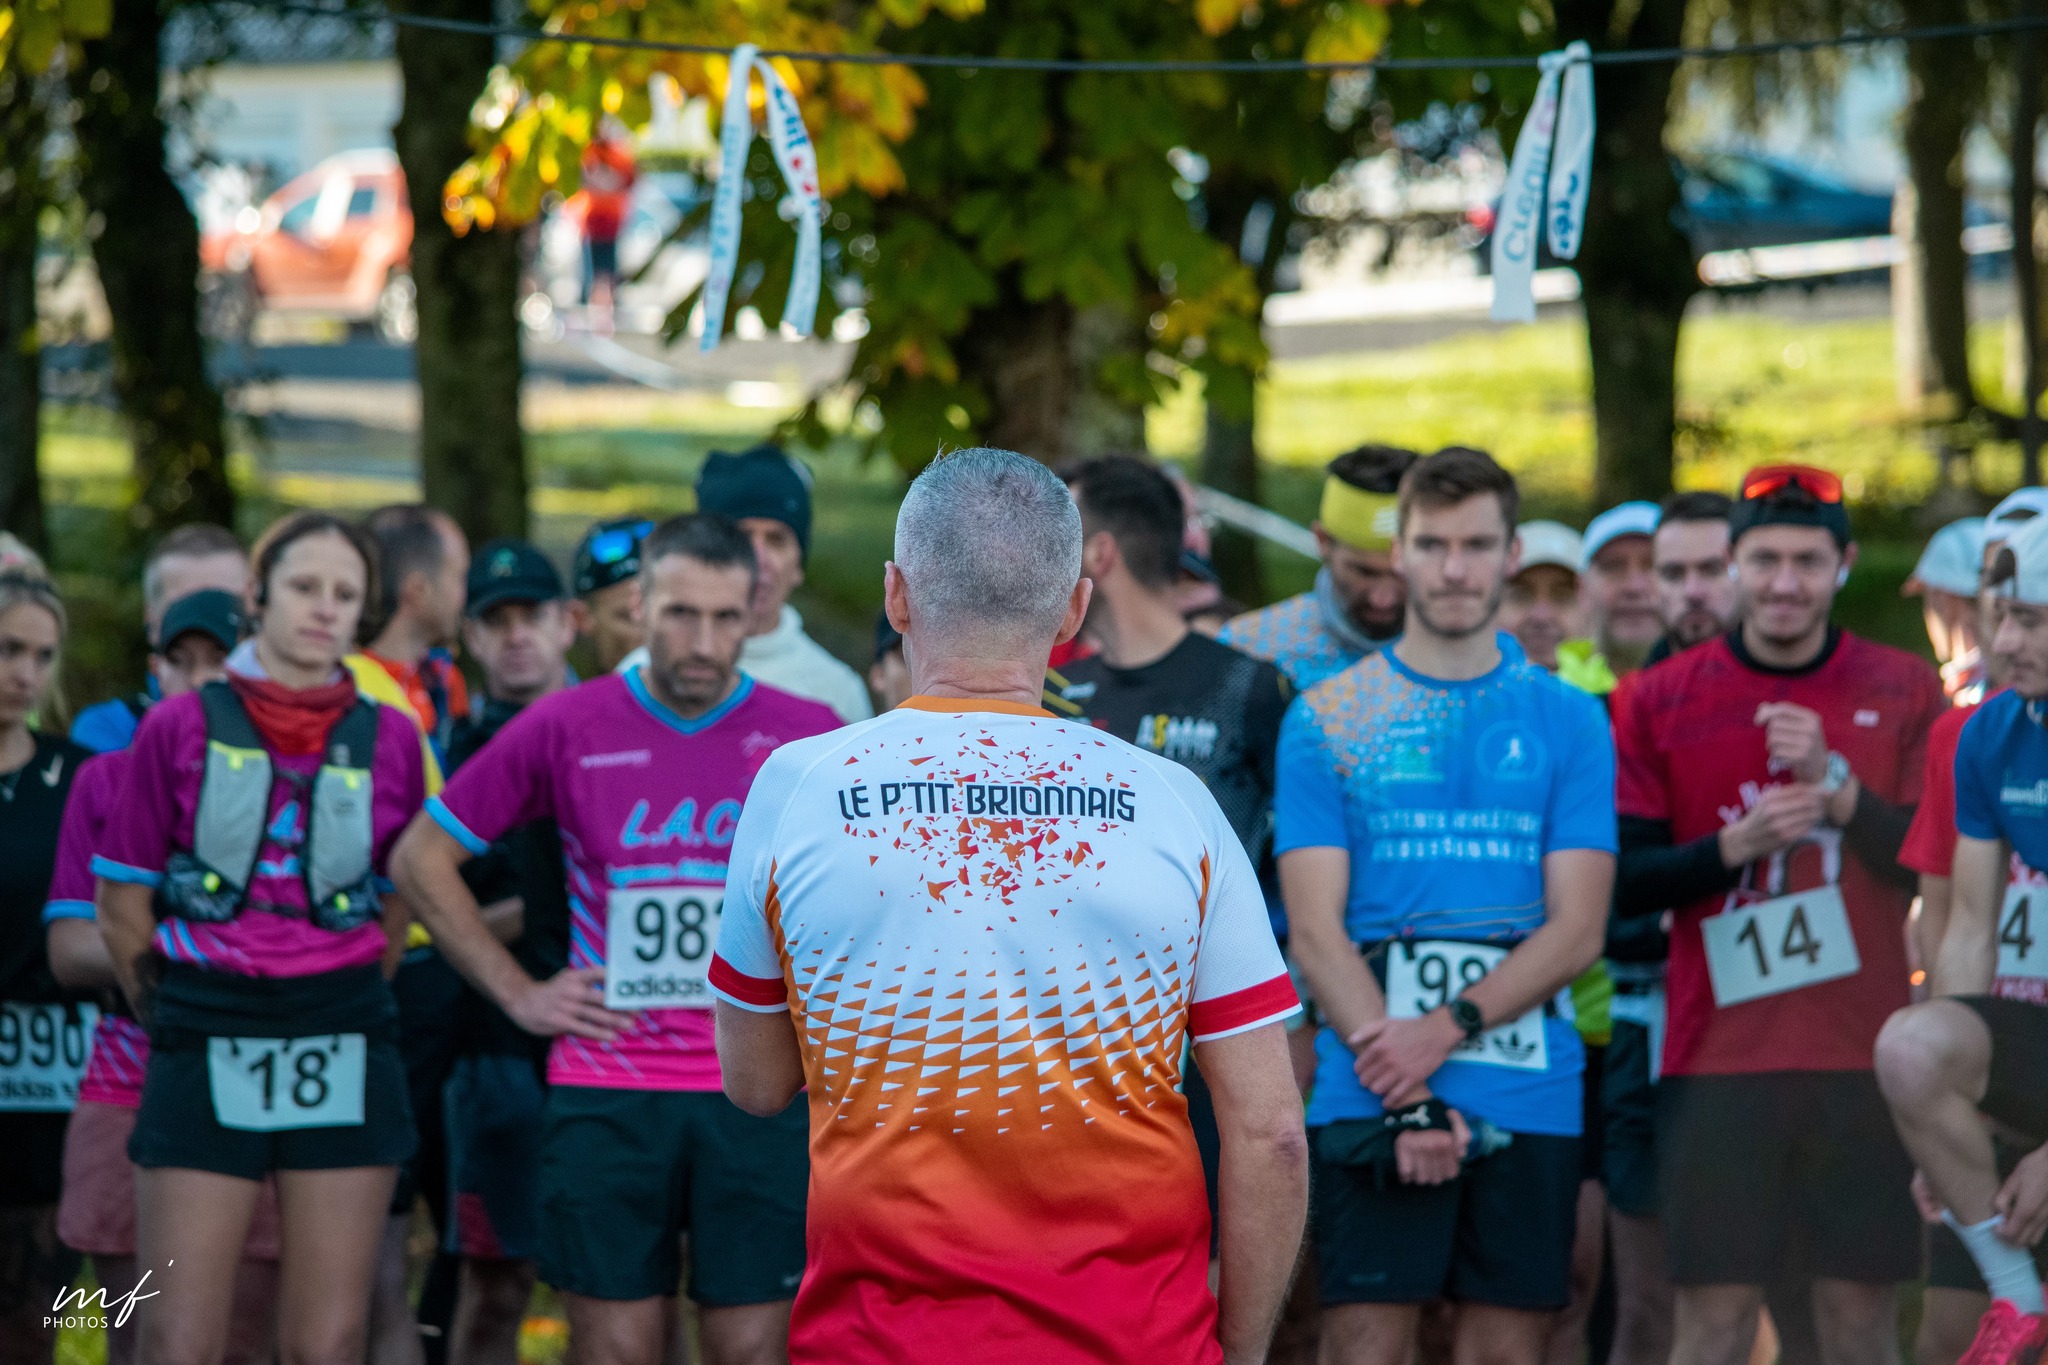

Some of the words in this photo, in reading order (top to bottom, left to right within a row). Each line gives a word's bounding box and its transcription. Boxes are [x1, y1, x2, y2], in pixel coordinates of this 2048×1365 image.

[838, 785, 871, 820] LE
[880, 781, 955, 816] P'TIT
[634, 898, 724, 962] 98
[1735, 903, 1823, 976] 14
[248, 1050, 328, 1111] 18
